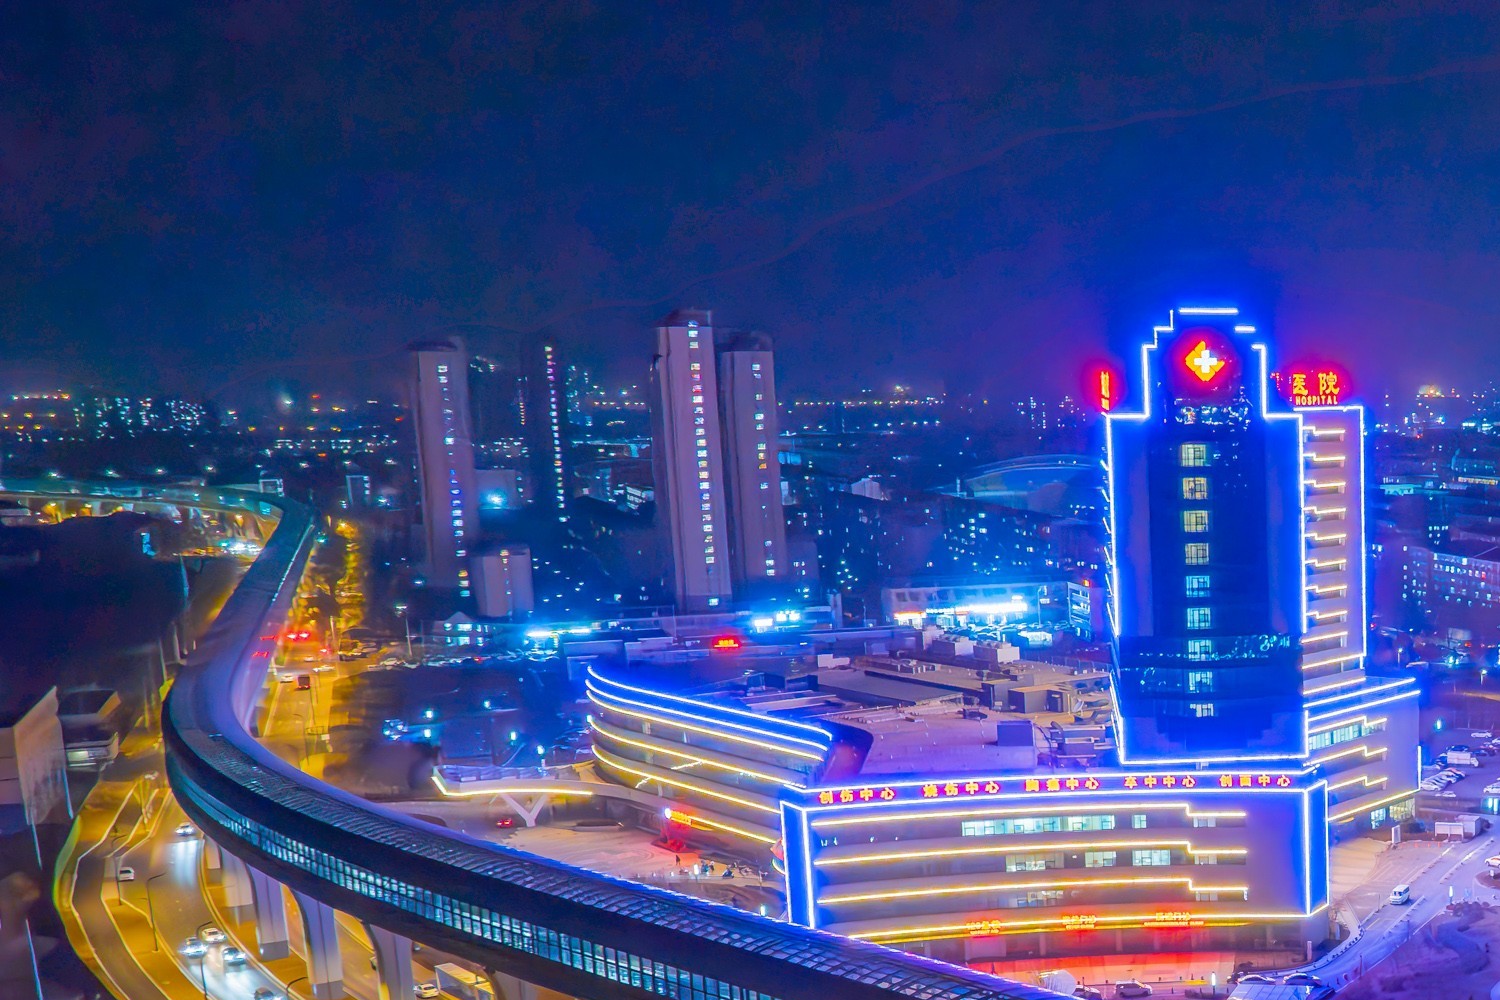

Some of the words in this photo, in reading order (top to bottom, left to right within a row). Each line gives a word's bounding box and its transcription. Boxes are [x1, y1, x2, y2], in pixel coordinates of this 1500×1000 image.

[1292, 371, 1340, 395] 医院
[1295, 396, 1338, 405] HOSPITAL
[819, 787, 895, 804] 创伤中心
[1124, 775, 1195, 789] 卒中中心
[1219, 774, 1290, 787] 创面中心
